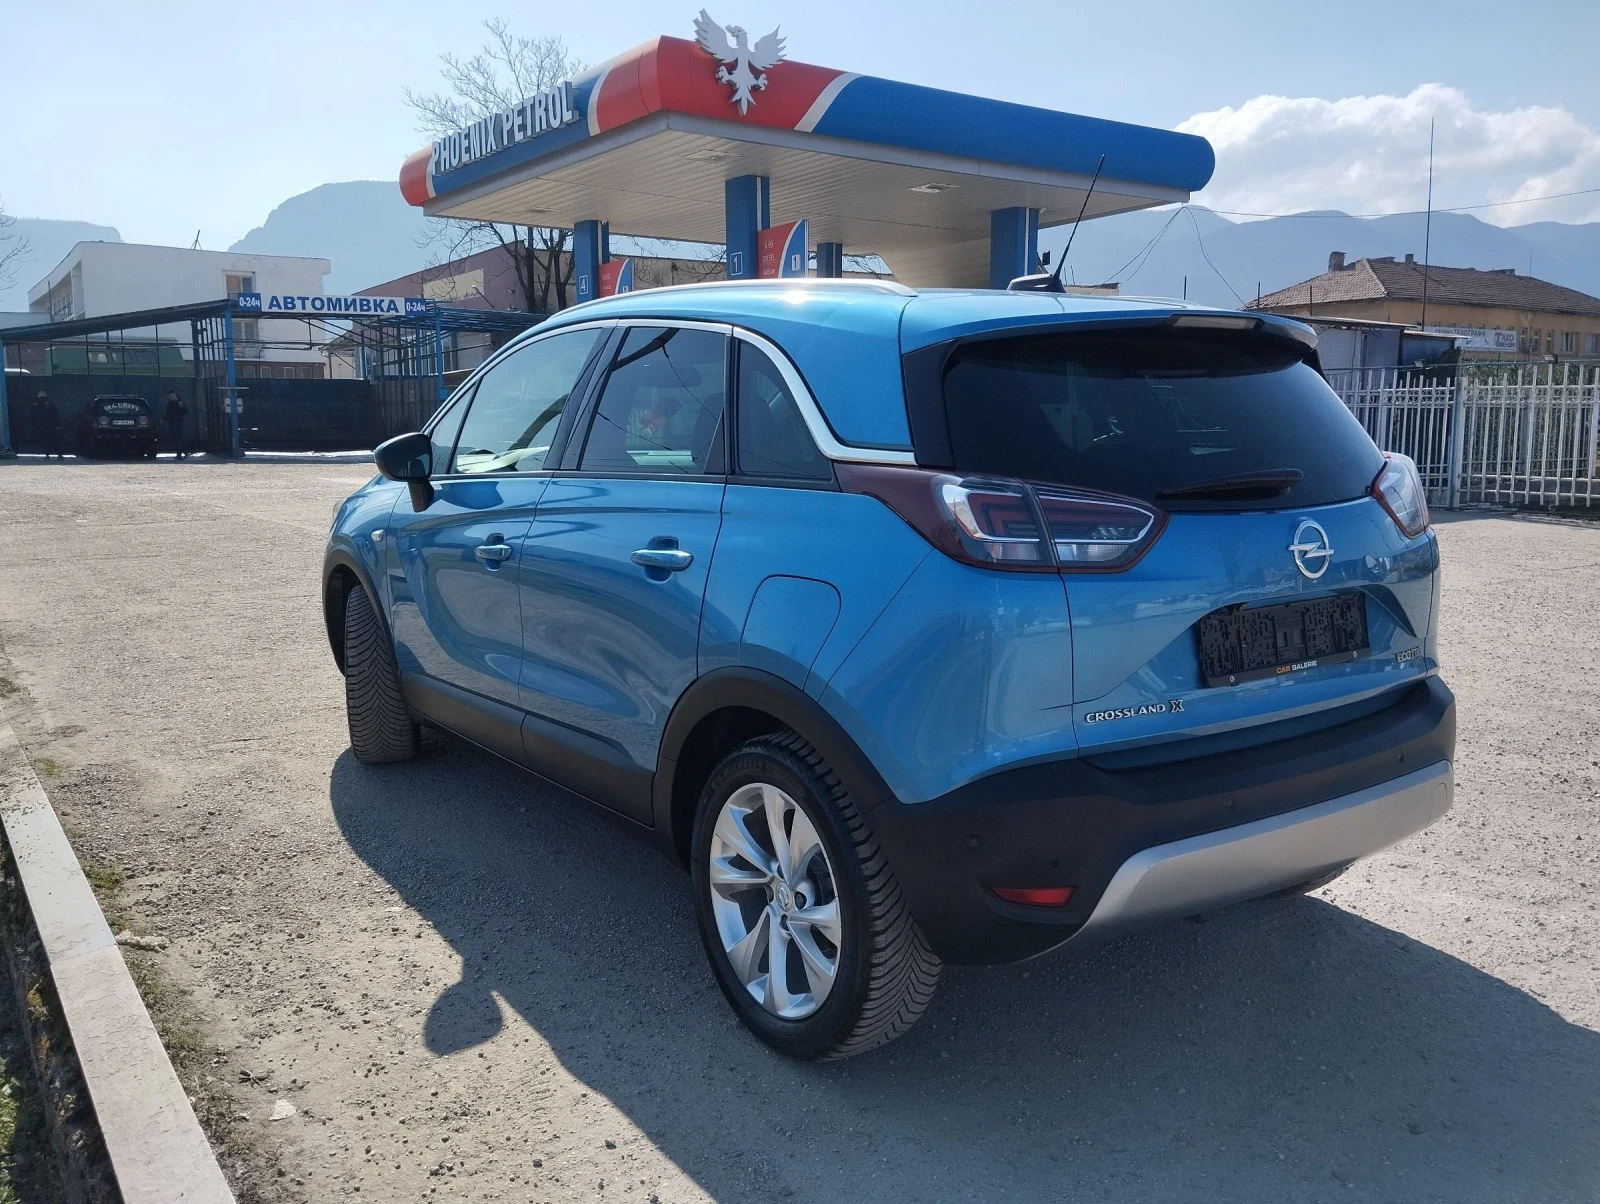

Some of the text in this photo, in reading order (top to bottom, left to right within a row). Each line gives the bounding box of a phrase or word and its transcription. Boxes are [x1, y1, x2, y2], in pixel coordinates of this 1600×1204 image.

[431, 81, 575, 176] PHOENIX PETROL
[238, 297, 261, 308] 0-24ч
[267, 295, 400, 313] АВТОМИВКА
[405, 301, 426, 312] 0-24ч
[1276, 660, 1318, 674] CAR GALERIE
[1085, 699, 1185, 723] CROSSLAND X
